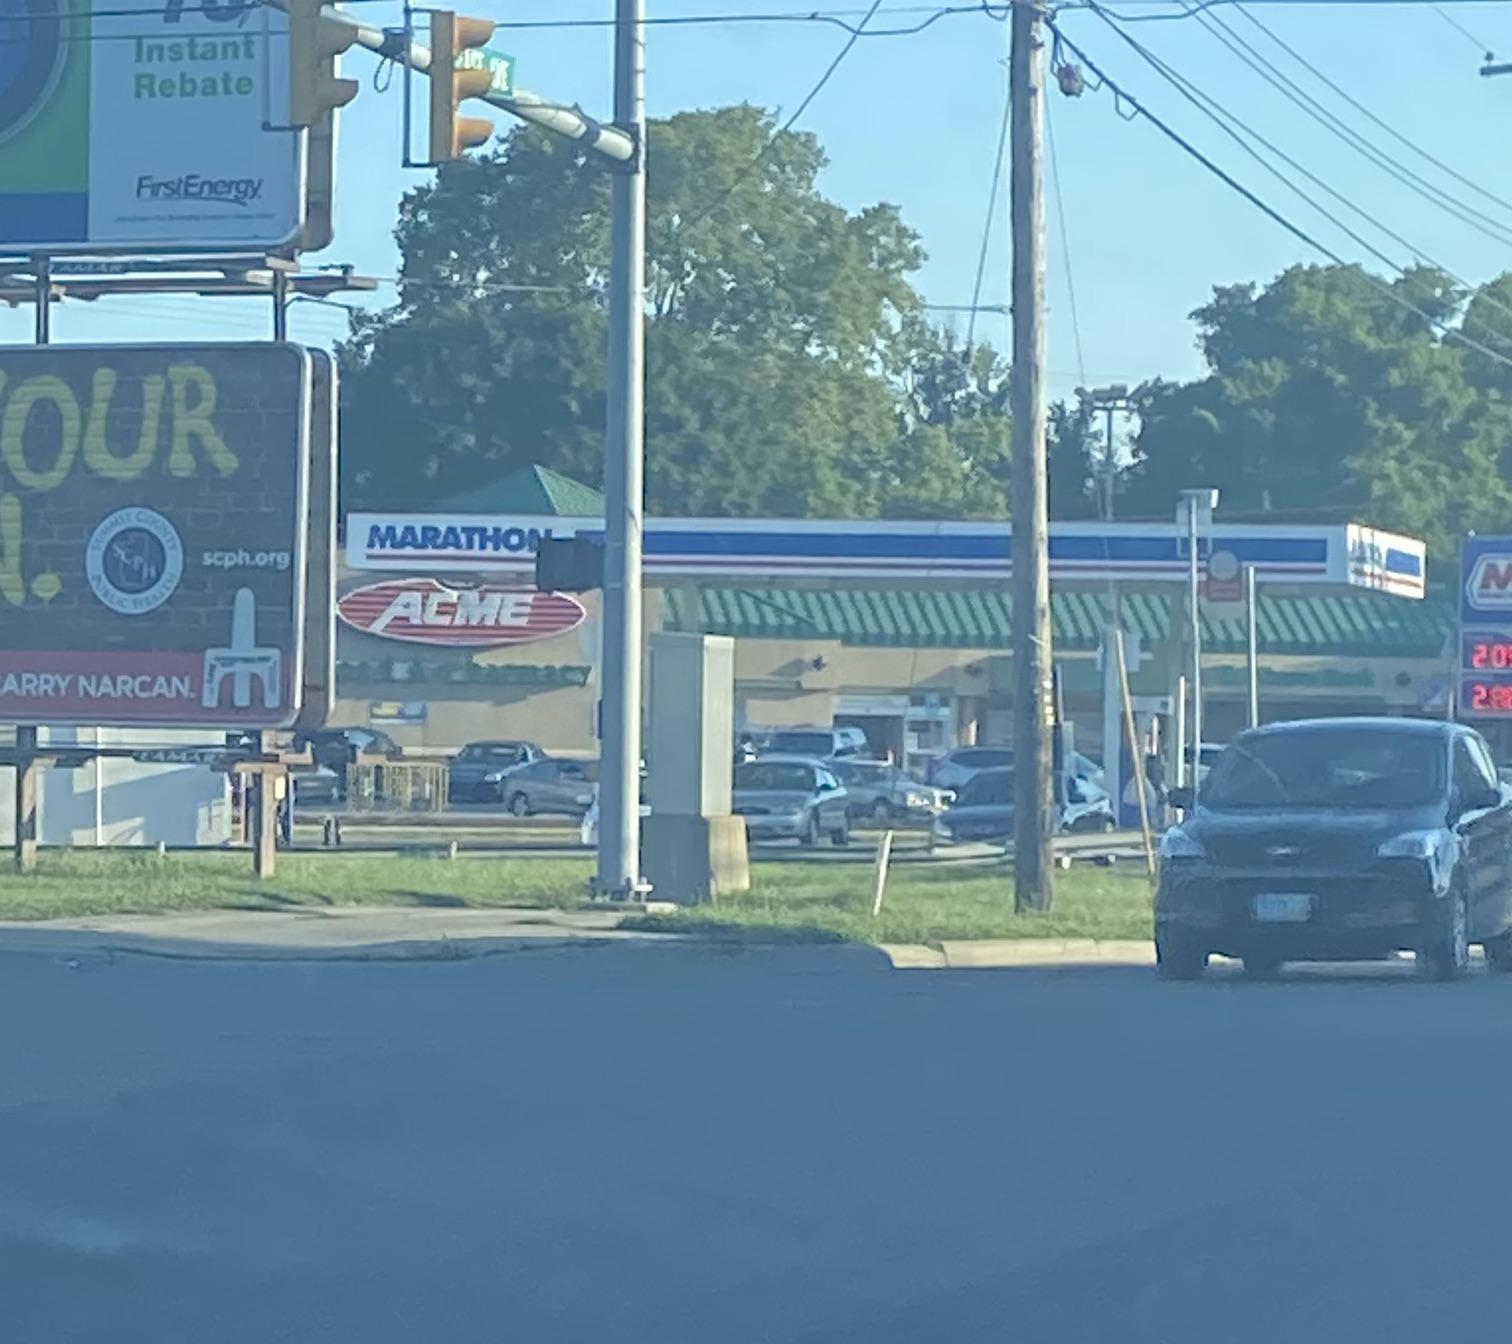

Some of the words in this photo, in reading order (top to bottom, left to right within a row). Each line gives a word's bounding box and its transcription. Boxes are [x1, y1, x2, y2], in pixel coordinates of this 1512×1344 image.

[134, 36, 255, 63] Instant
[134, 72, 253, 99] Rebate
[366, 524, 553, 553] MARATHON
[202, 549, 290, 570] scph.org
[369, 591, 535, 634] ACME
[78, 674, 196, 698] NARCAN.
